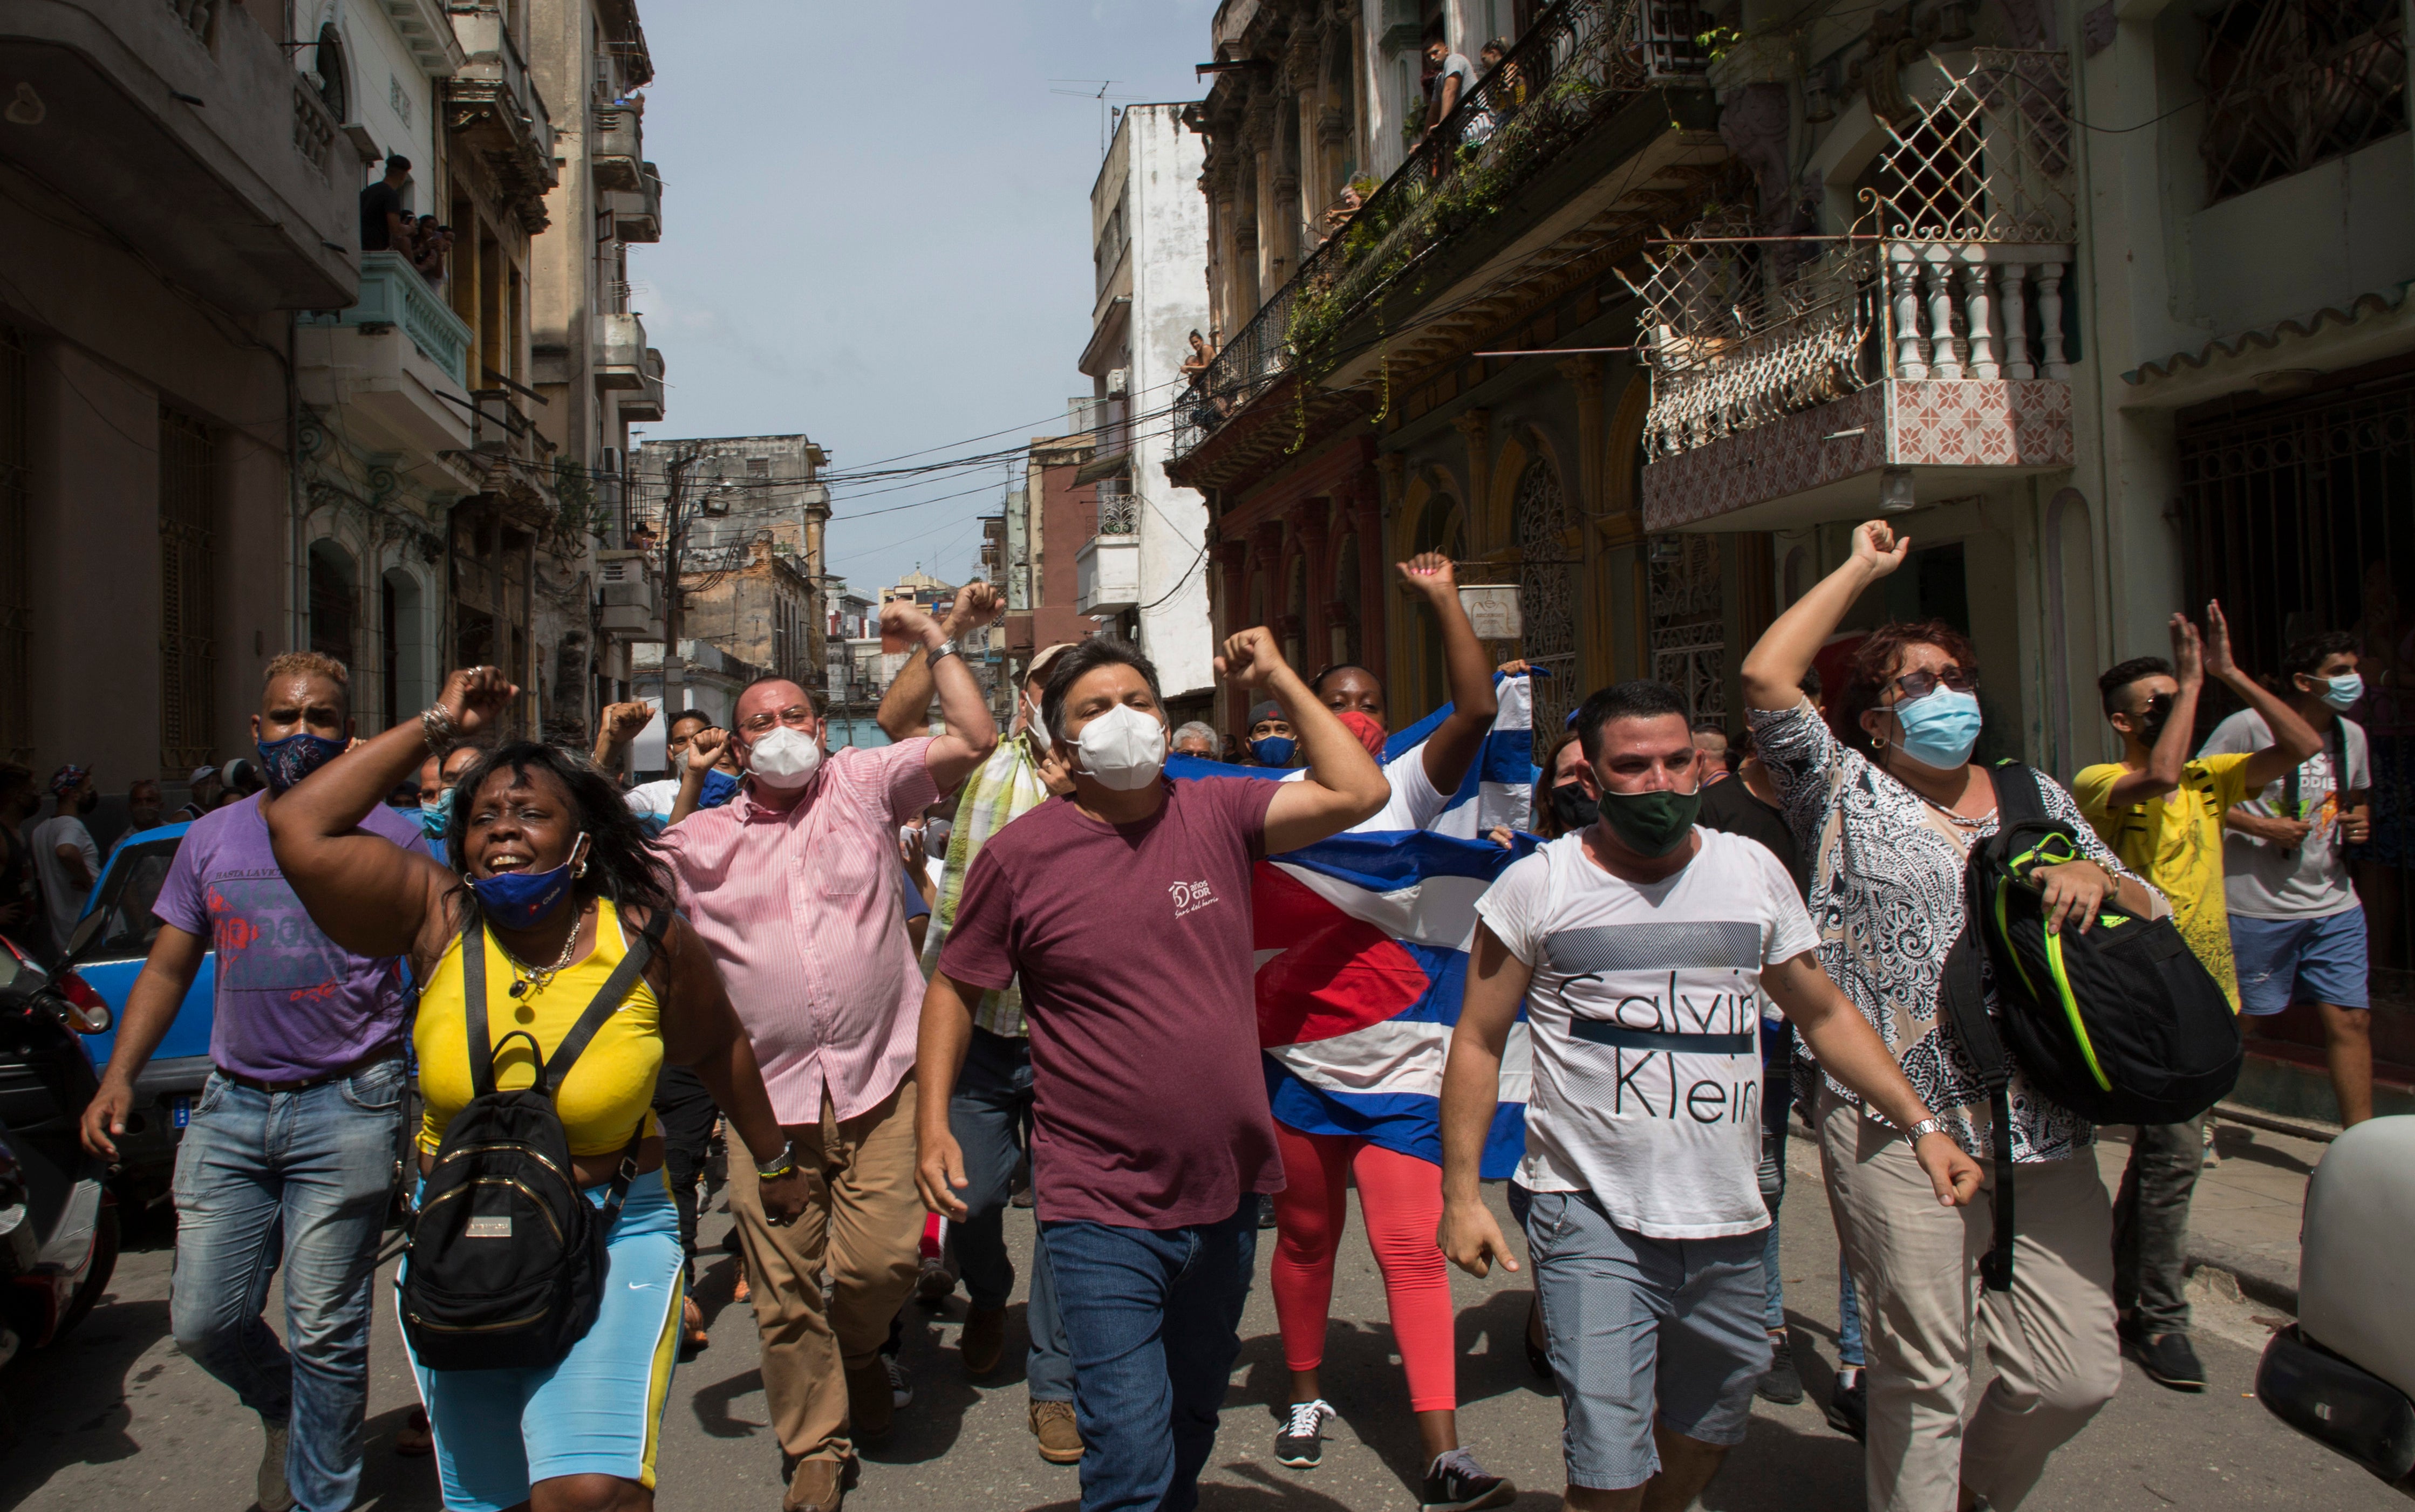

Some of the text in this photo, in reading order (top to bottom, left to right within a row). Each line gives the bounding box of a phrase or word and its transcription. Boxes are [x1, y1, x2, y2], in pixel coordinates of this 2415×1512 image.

[216, 869, 243, 880] HASTA
[261, 868, 283, 877] VICT
[1190, 880, 1208, 892] años
[1192, 887, 1211, 900] CDR
[1191, 900, 1202, 911] del
[1558, 969, 1755, 1036] Calvin
[1615, 1045, 1758, 1124] Klein
